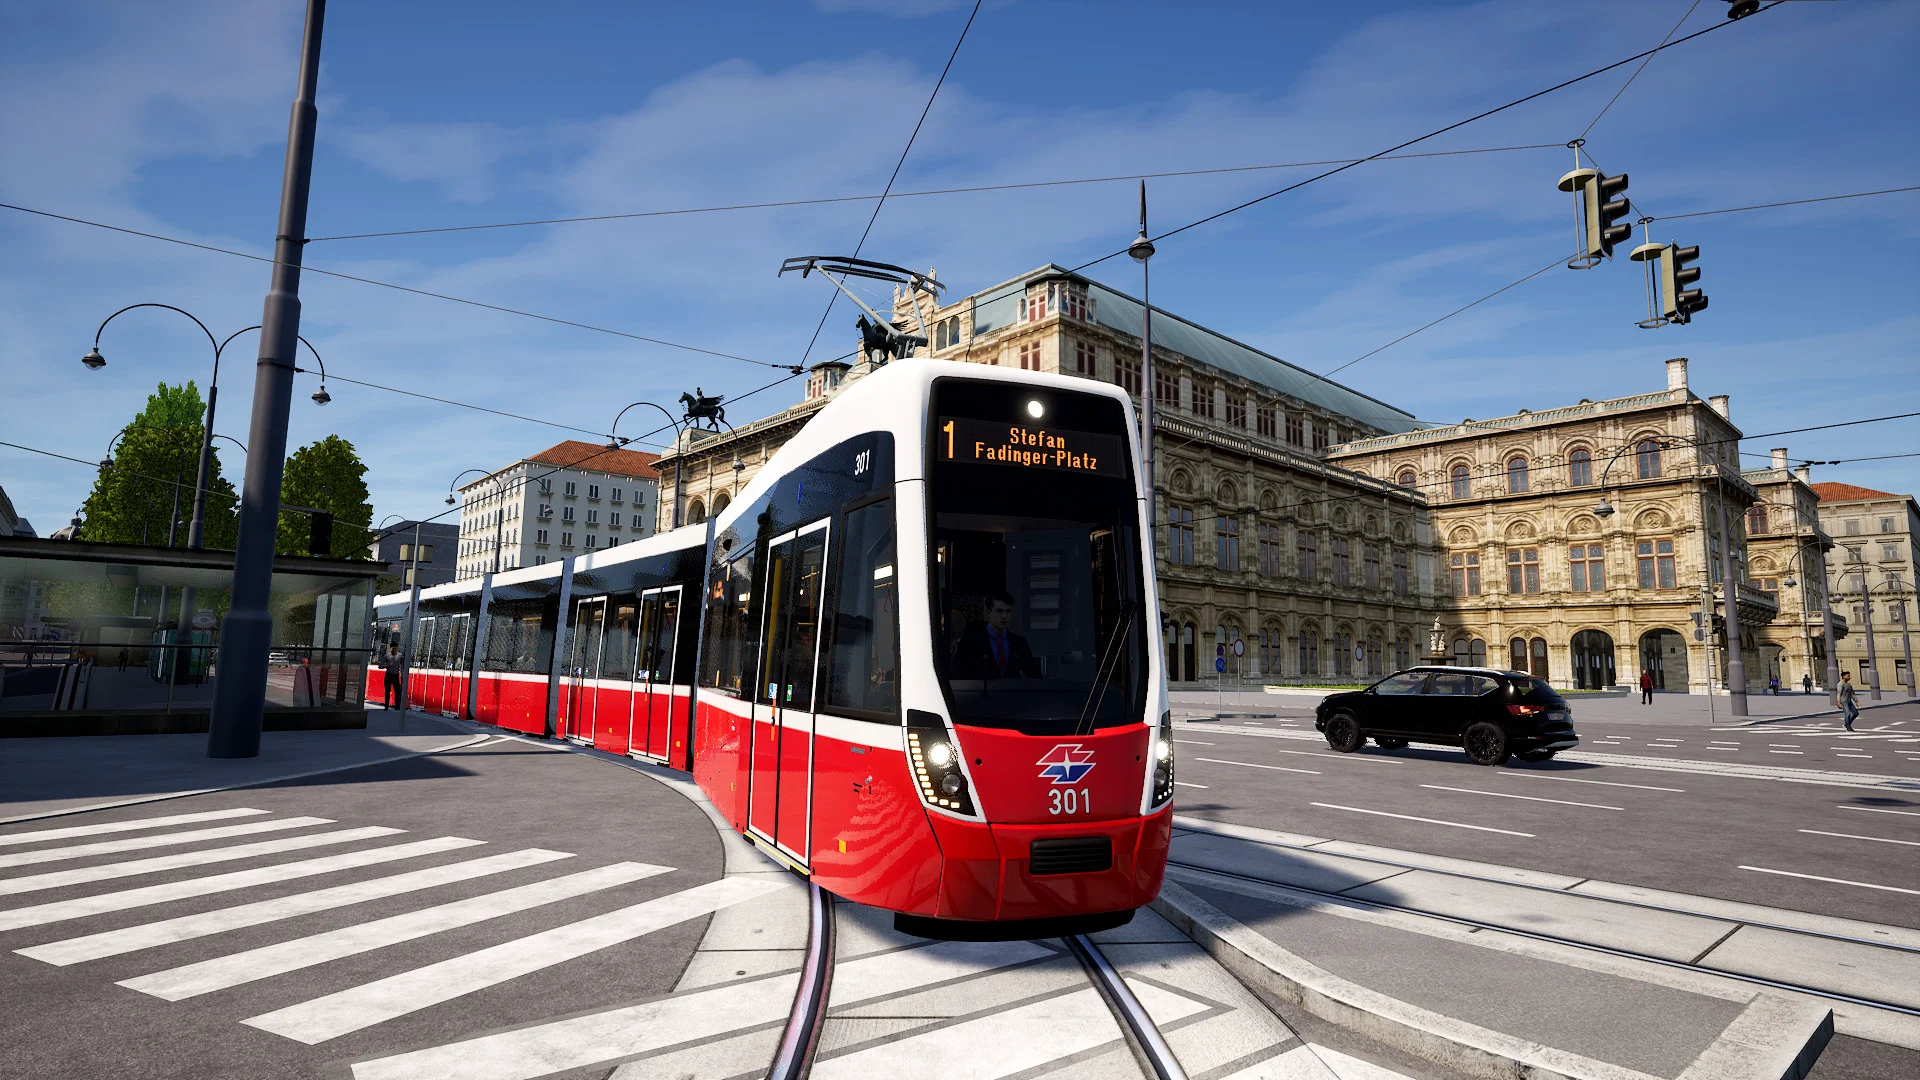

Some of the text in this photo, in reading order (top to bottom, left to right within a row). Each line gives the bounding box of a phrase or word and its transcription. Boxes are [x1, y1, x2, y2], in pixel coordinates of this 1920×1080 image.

[943, 420, 954, 459] 1
[1010, 427, 1065, 449] Stefan
[854, 449, 870, 476] 301
[975, 441, 1097, 470] Fadinger-Platz
[1048, 788, 1090, 815] 301
